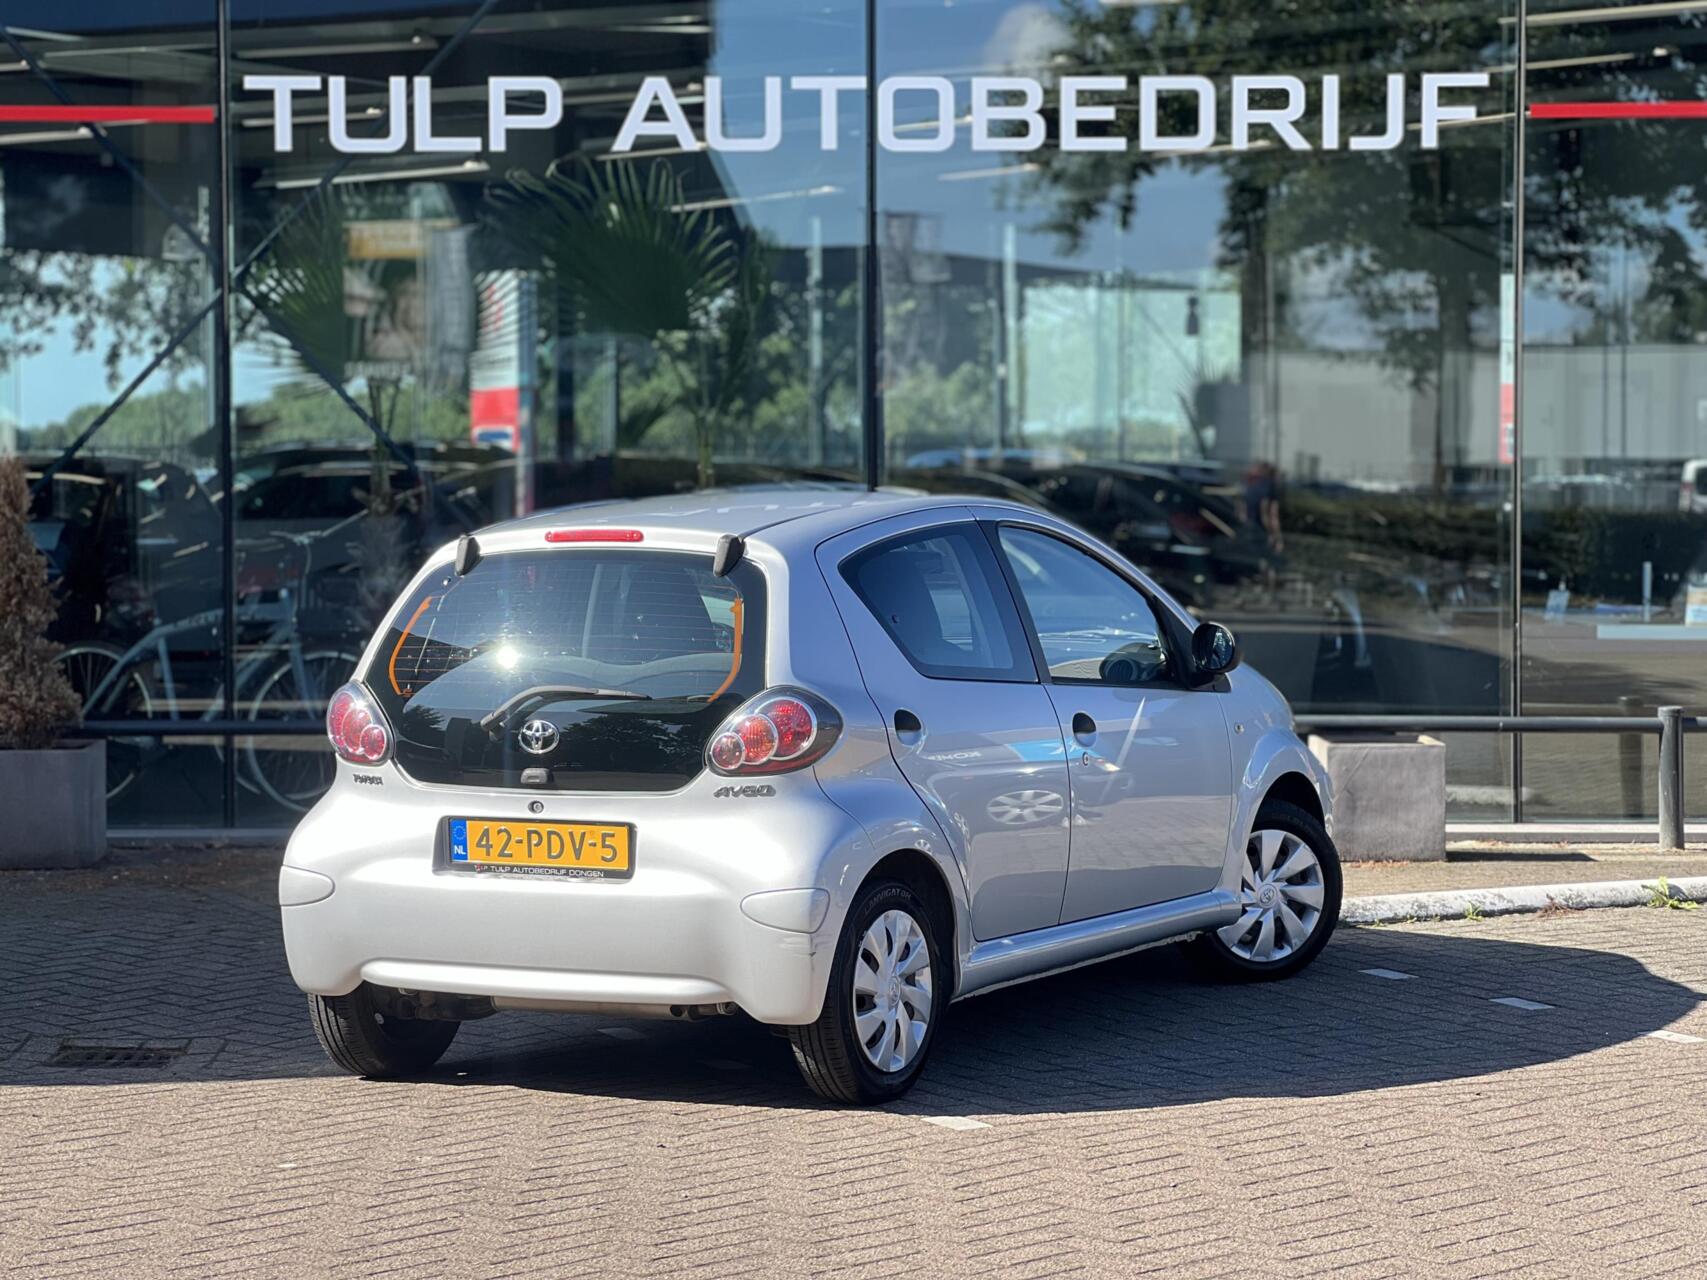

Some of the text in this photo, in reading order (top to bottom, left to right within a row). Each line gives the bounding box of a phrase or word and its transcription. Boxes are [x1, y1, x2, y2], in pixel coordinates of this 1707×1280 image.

[243, 72, 1491, 154] TULP AUTOBEDRIJF
[713, 784, 776, 798] AYGO
[453, 844, 466, 856] NL
[475, 825, 618, 863] 42-PDV-5
[490, 865, 511, 873] TULP
[513, 866, 567, 876] AUTOBEDRIJF
[568, 868, 604, 878] DONGEN
